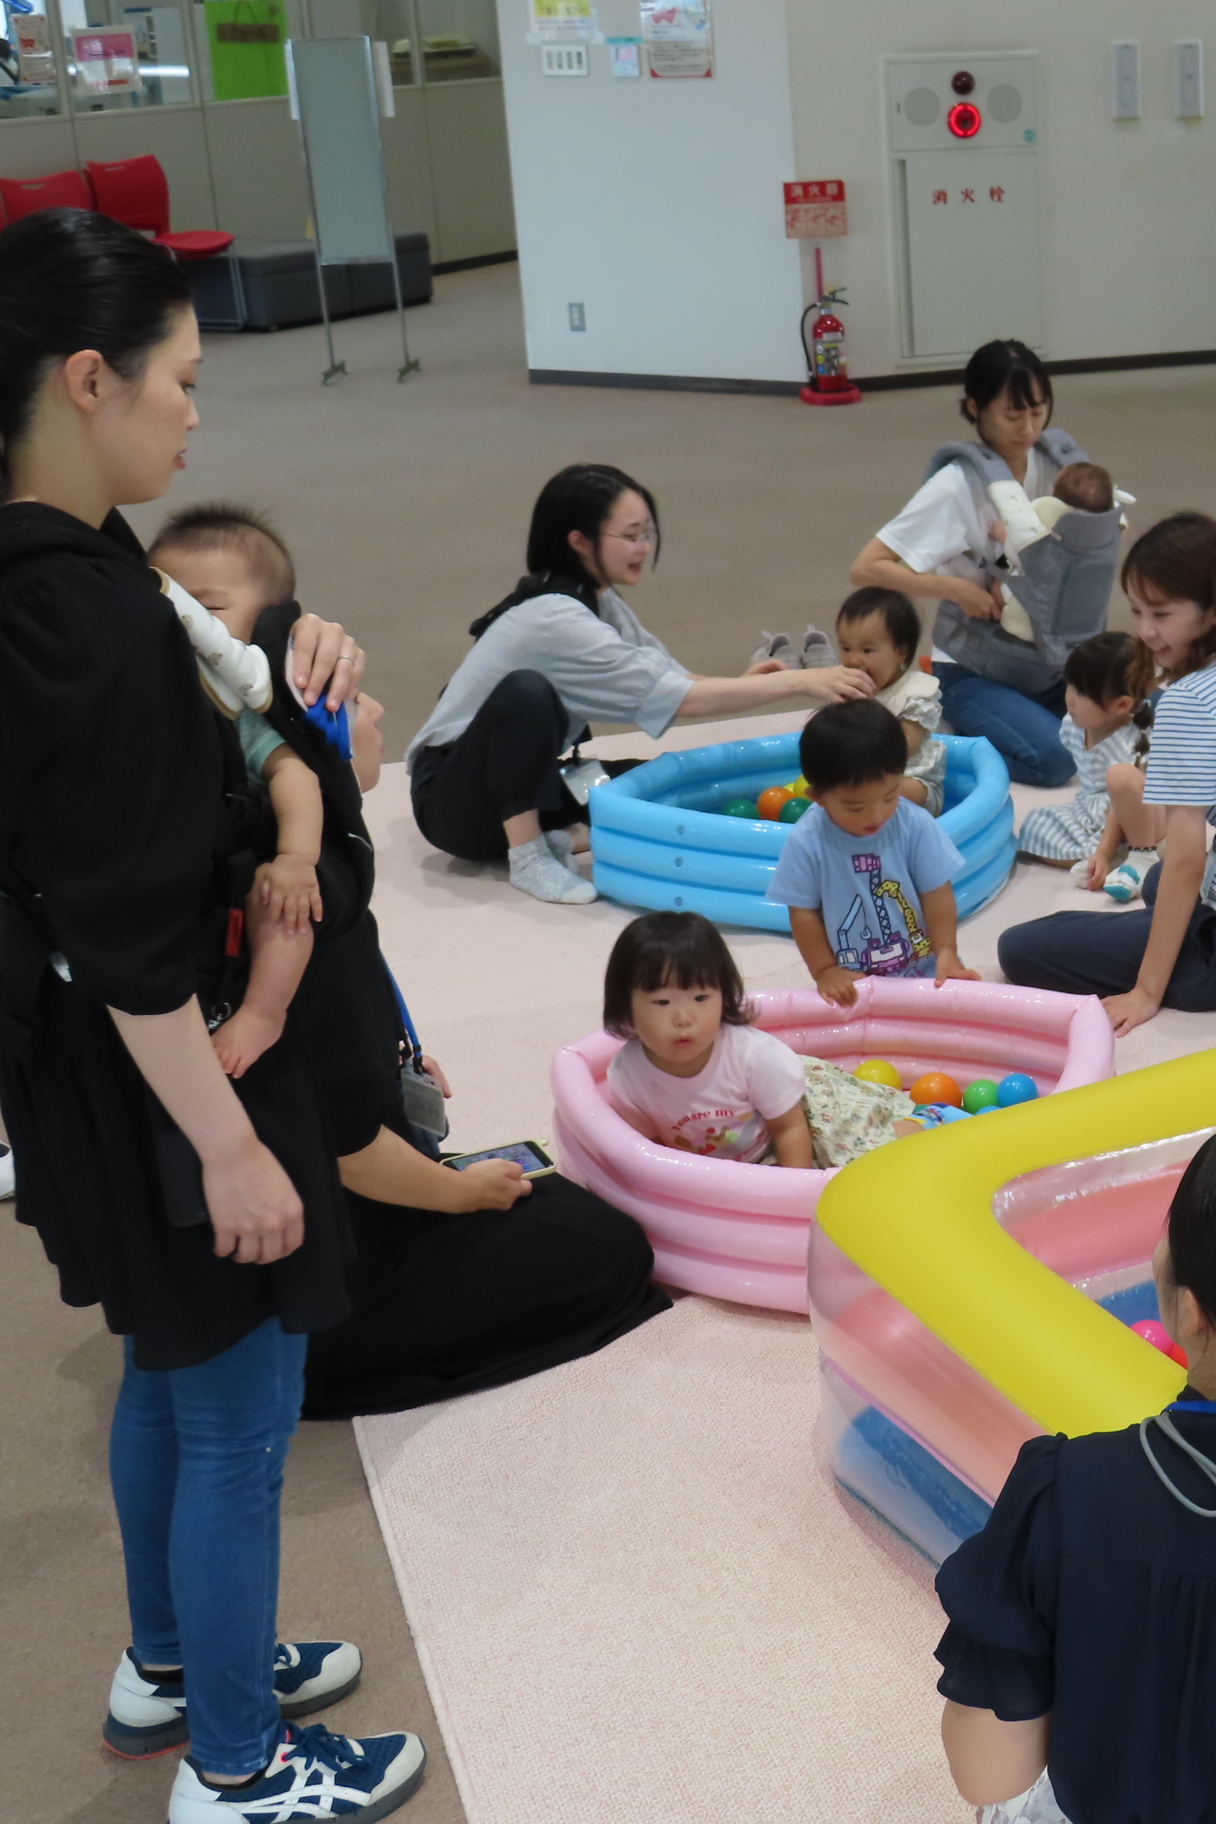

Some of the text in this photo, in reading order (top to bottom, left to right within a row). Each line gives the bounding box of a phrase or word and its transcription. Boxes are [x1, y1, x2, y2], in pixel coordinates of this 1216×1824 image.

[791, 183, 838, 197] 消火器
[932, 186, 1005, 205] 消火栓
